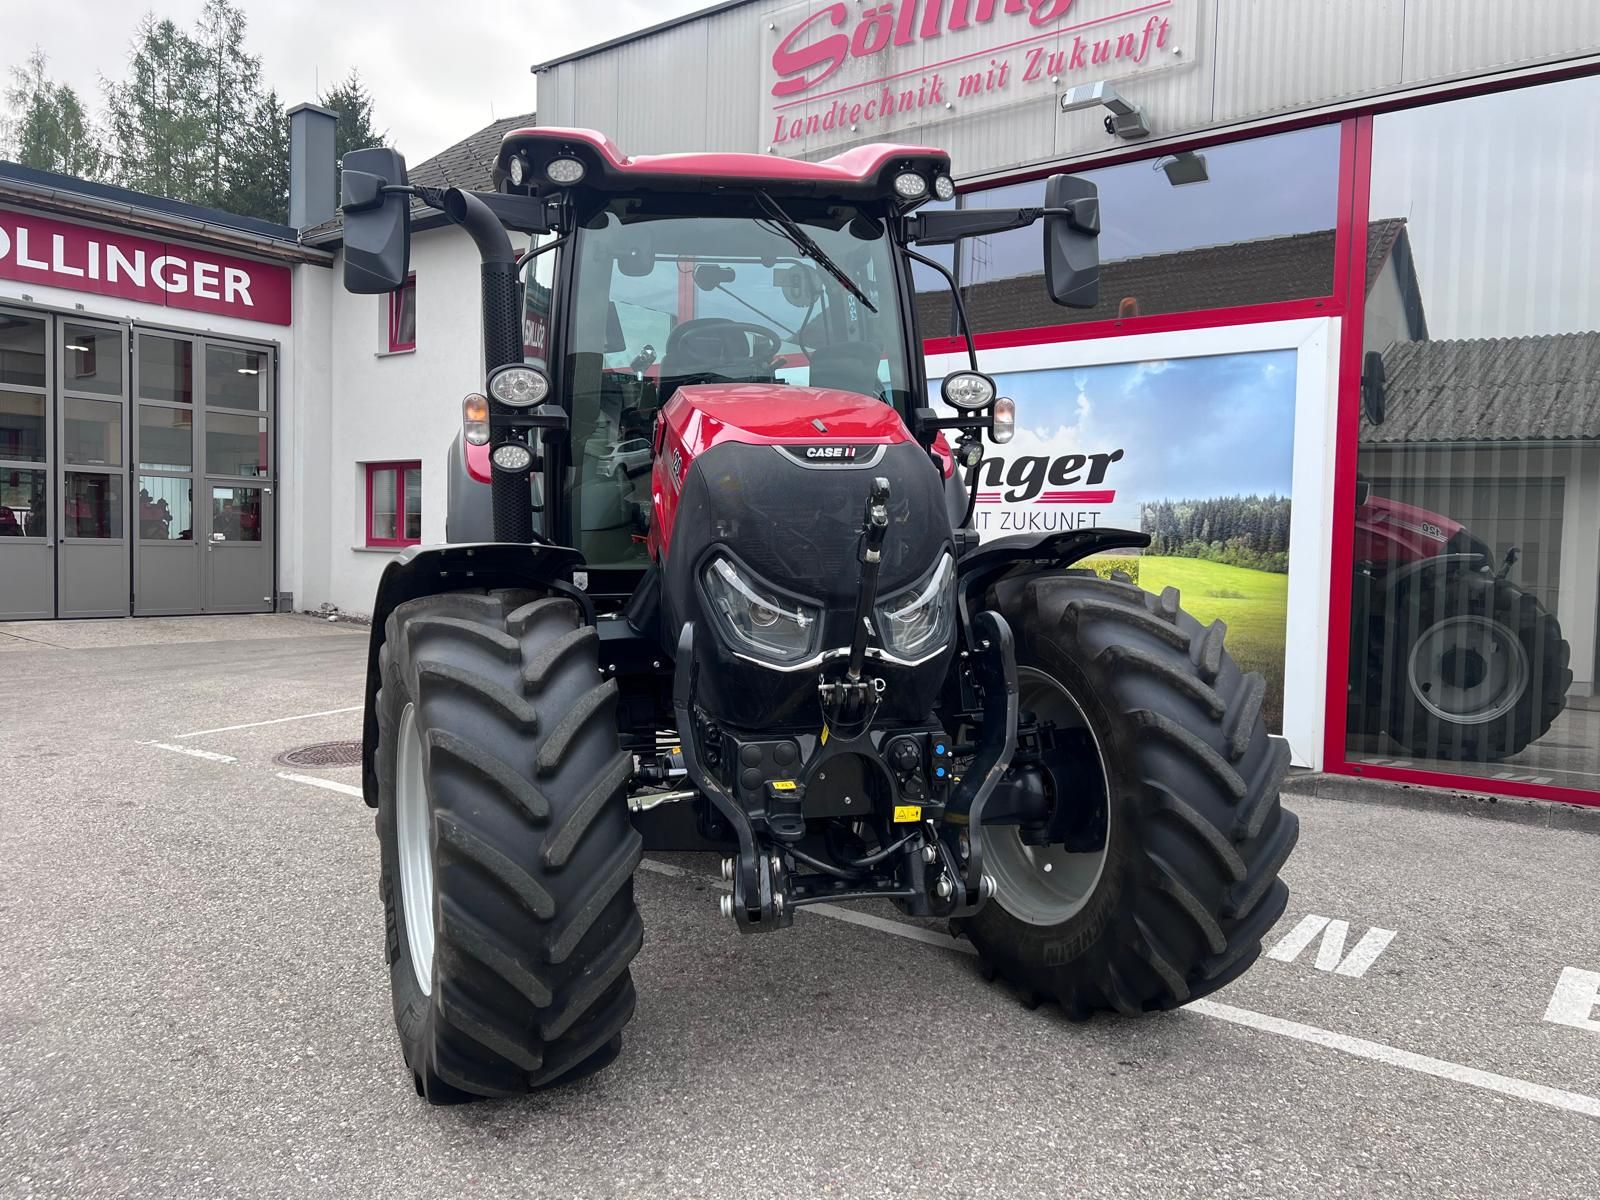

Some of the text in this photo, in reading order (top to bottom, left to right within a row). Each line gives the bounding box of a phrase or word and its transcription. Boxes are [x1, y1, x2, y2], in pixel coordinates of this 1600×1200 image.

[772, 15, 1169, 143] Landtechnik mit Zukunft
[806, 447, 843, 458] CASE
[1000, 511, 1101, 530] ZUKUNFT
